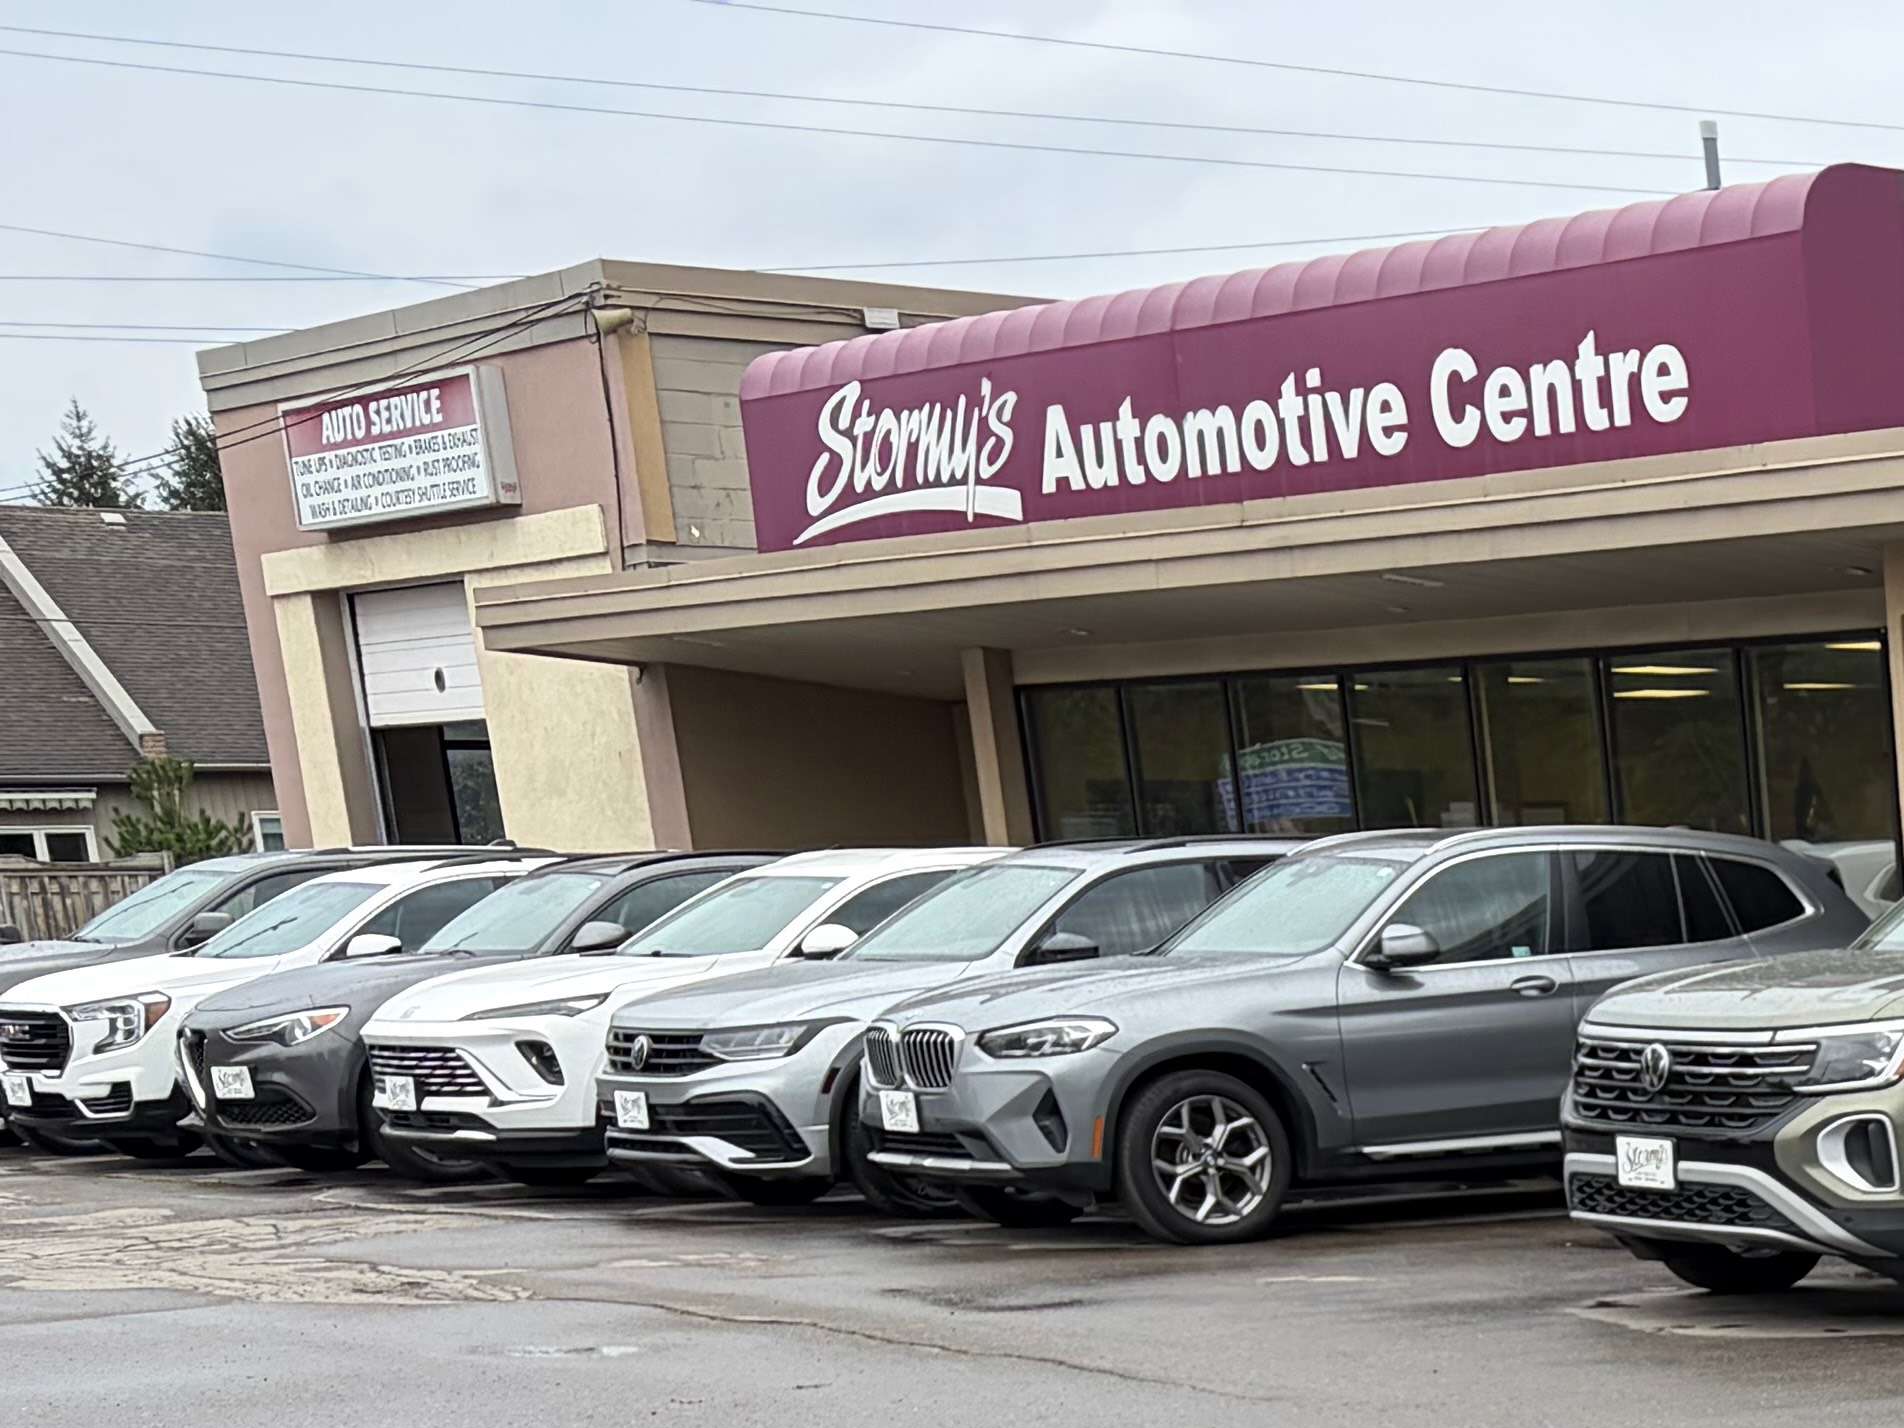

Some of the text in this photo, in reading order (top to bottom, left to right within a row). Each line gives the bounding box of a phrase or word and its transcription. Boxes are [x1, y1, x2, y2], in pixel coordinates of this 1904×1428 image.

[322, 388, 443, 444] AUTO SERVICE
[804, 329, 1690, 522] Stormy's Automotive Centre
[334, 447, 377, 470] DIAGNOSTIC
[378, 441, 407, 461] TESTING
[413, 435, 440, 455] BRAKES
[441, 434, 448, 451] &
[448, 428, 480, 449] EXHAUST
[301, 452, 481, 498] OIL CHANGE AIR CONDITIONING RUST PROOFING
[309, 502, 331, 519] WASH
[338, 494, 372, 515] DETAILING
[381, 487, 416, 508] COURTESY
[417, 482, 447, 503] SHUTTLE
[447, 477, 477, 498] SERVICE
